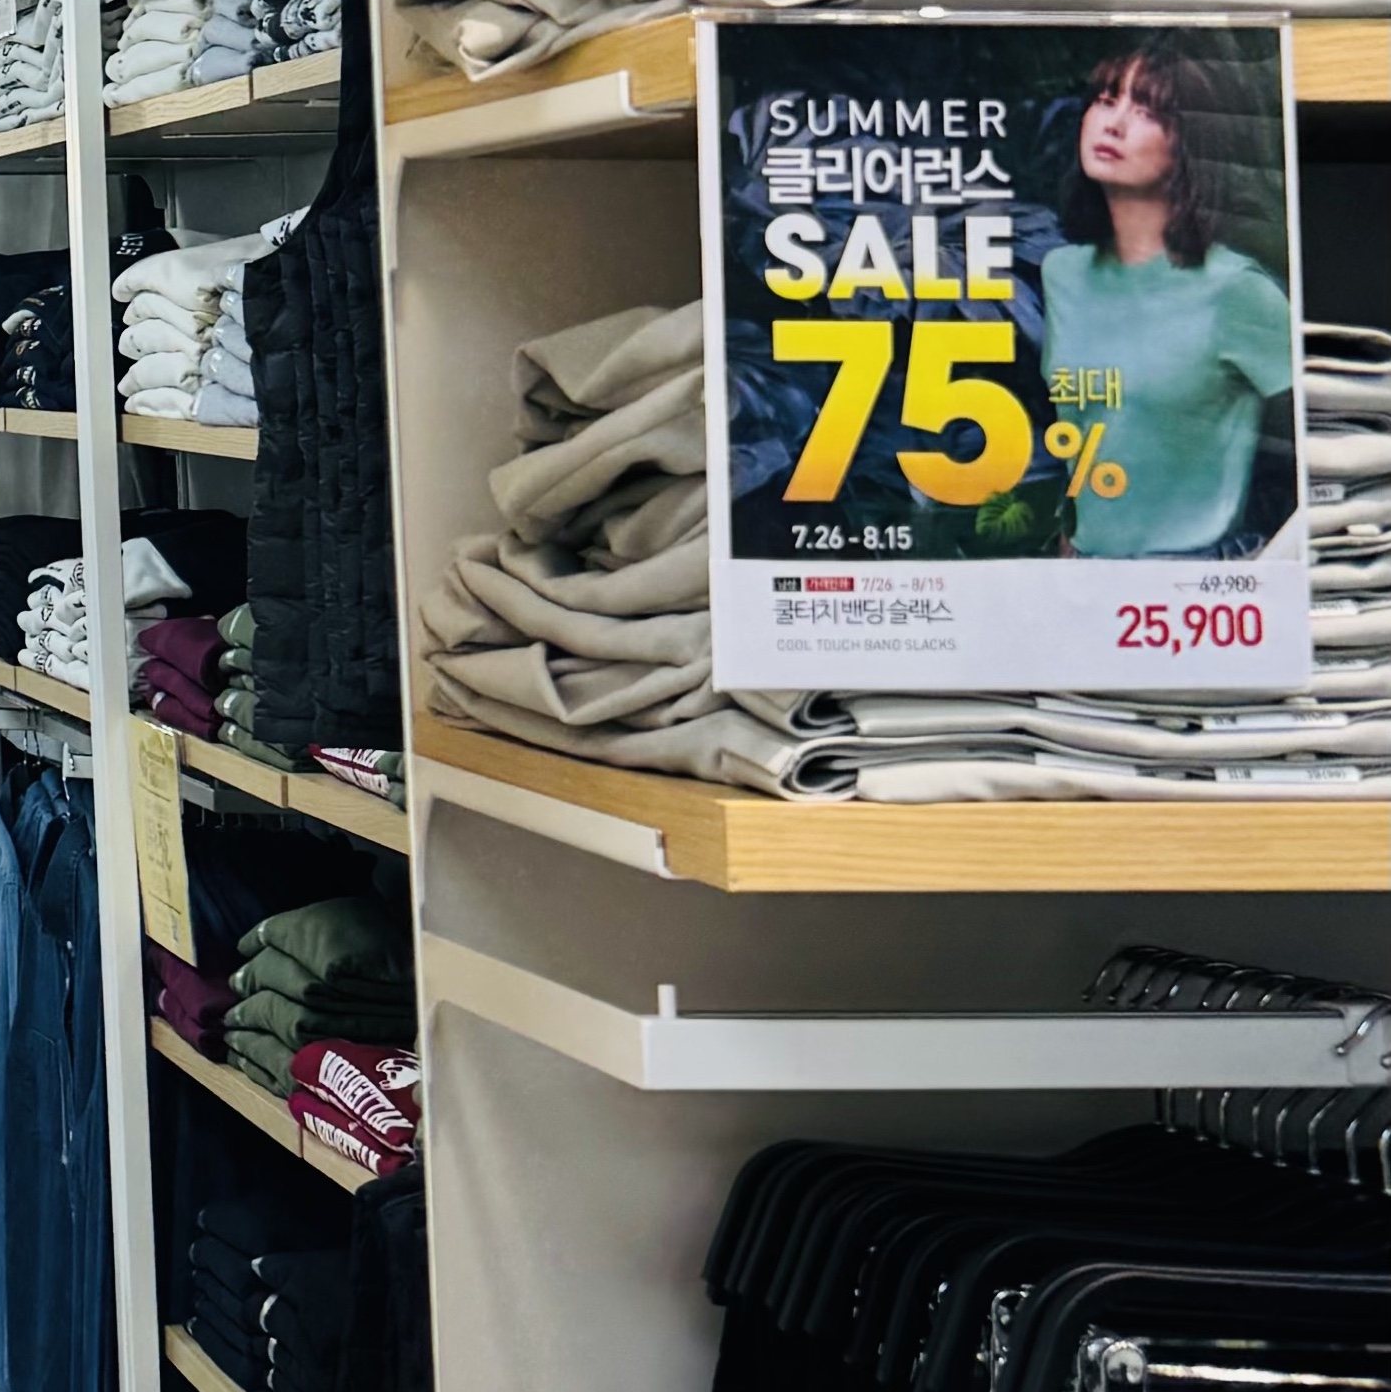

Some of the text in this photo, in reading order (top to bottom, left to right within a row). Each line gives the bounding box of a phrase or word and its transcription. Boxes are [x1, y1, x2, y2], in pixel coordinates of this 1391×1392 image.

[769, 99, 1008, 138] SUMMER
[761, 146, 1013, 205] 클리어런스
[764, 214, 1014, 301] SALE
[772, 320, 1034, 506] 75
[1048, 366, 1122, 410] 최대
[1044, 422, 1128, 499] %
[772, 598, 955, 626] 쿨터치 밴딩 슬랙스
[1116, 603, 1264, 657] 25,900
[776, 638, 814, 652] COOL
[817, 638, 862, 652] TOUCH
[904, 638, 957, 652] SLACKS
